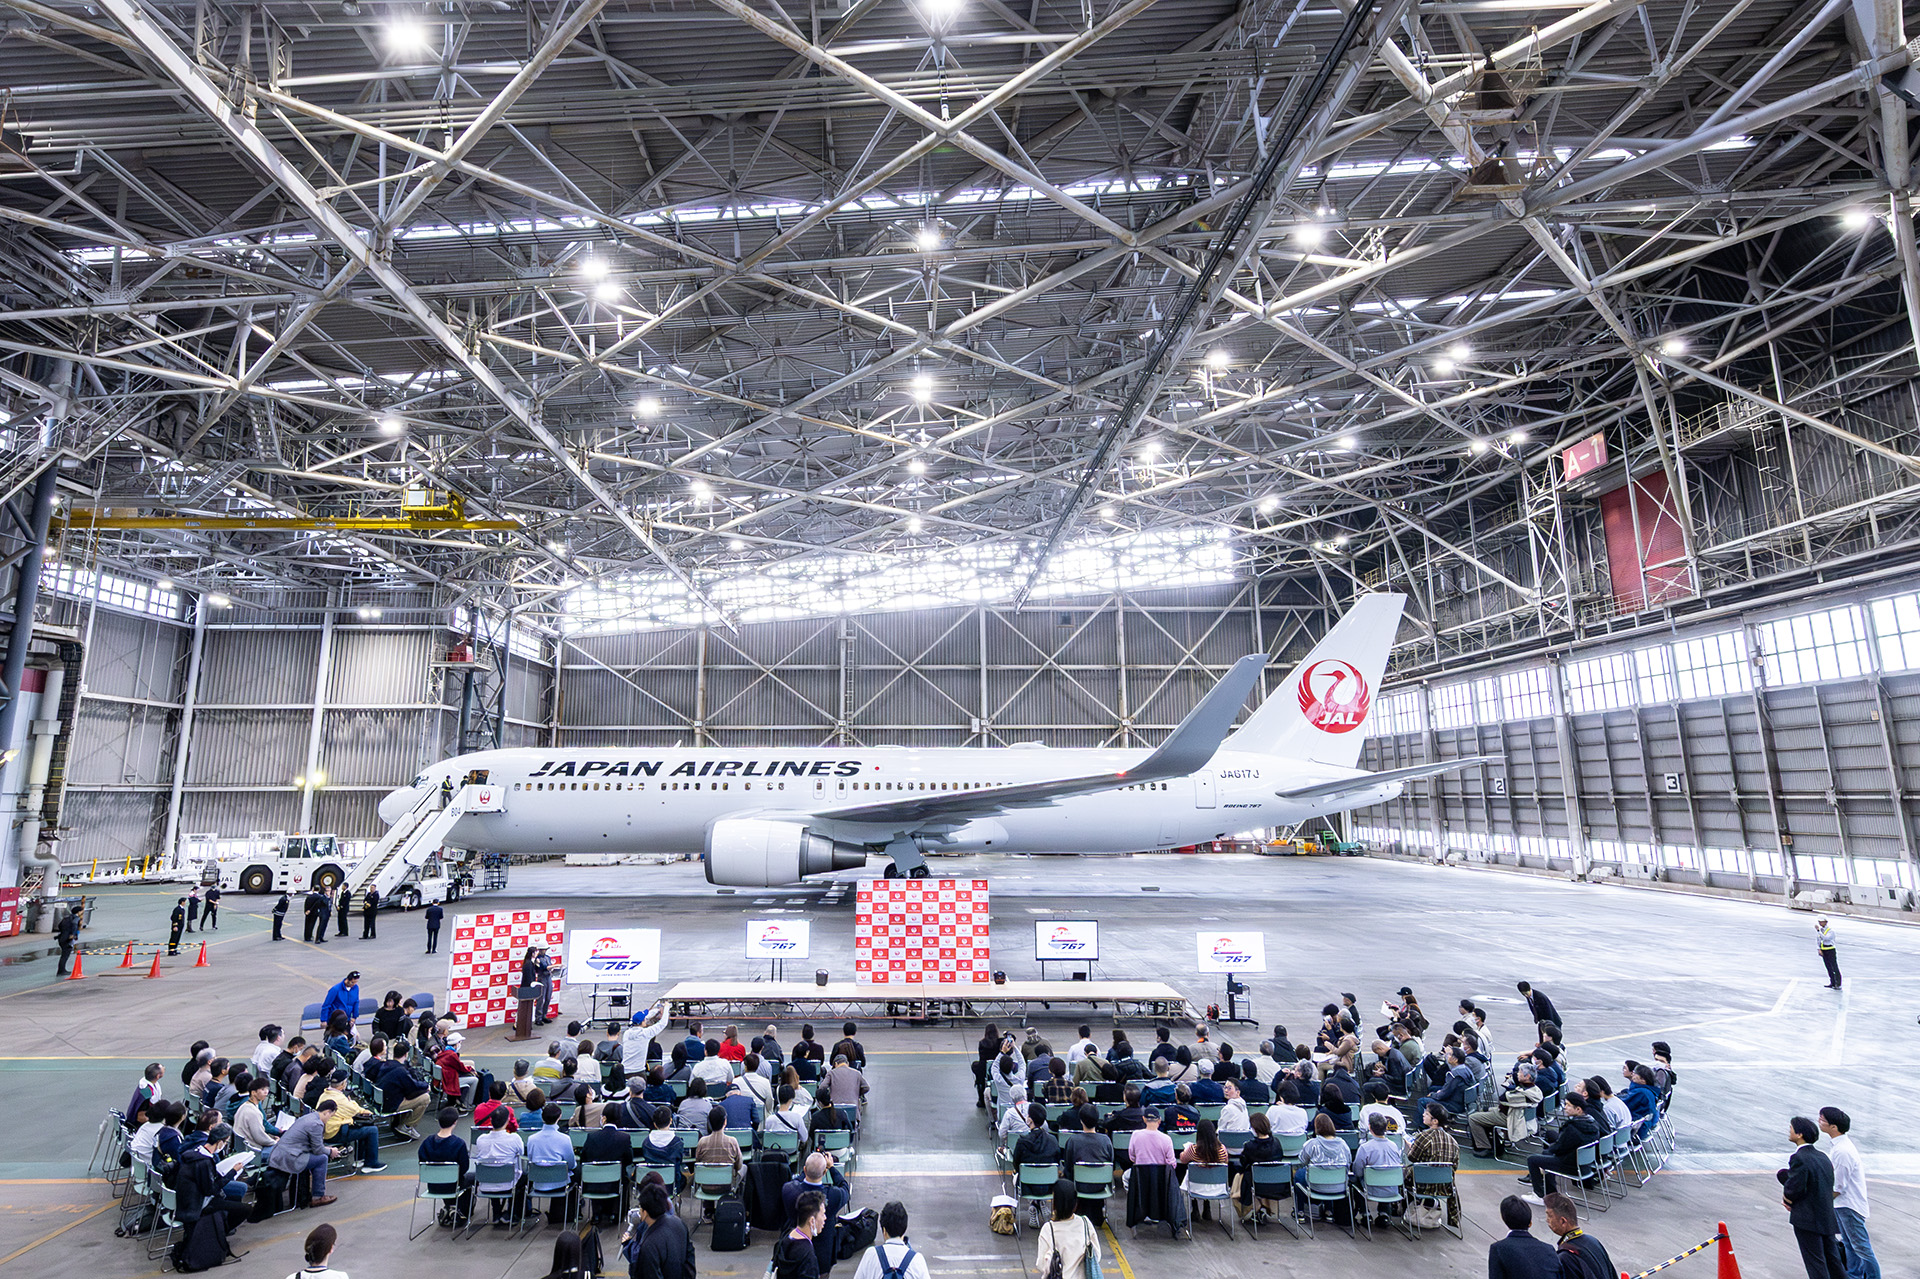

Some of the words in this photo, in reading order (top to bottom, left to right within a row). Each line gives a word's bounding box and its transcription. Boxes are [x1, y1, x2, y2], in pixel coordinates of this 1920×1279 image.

[1567, 438, 1600, 477] A-1
[1319, 711, 1358, 724] JAL
[528, 761, 664, 777] JAPAN
[669, 761, 862, 777] AIRLINES
[1220, 769, 1260, 778] JA617J
[1496, 780, 1504, 791] 2
[1666, 775, 1678, 789] 3
[605, 961, 642, 970] 767
